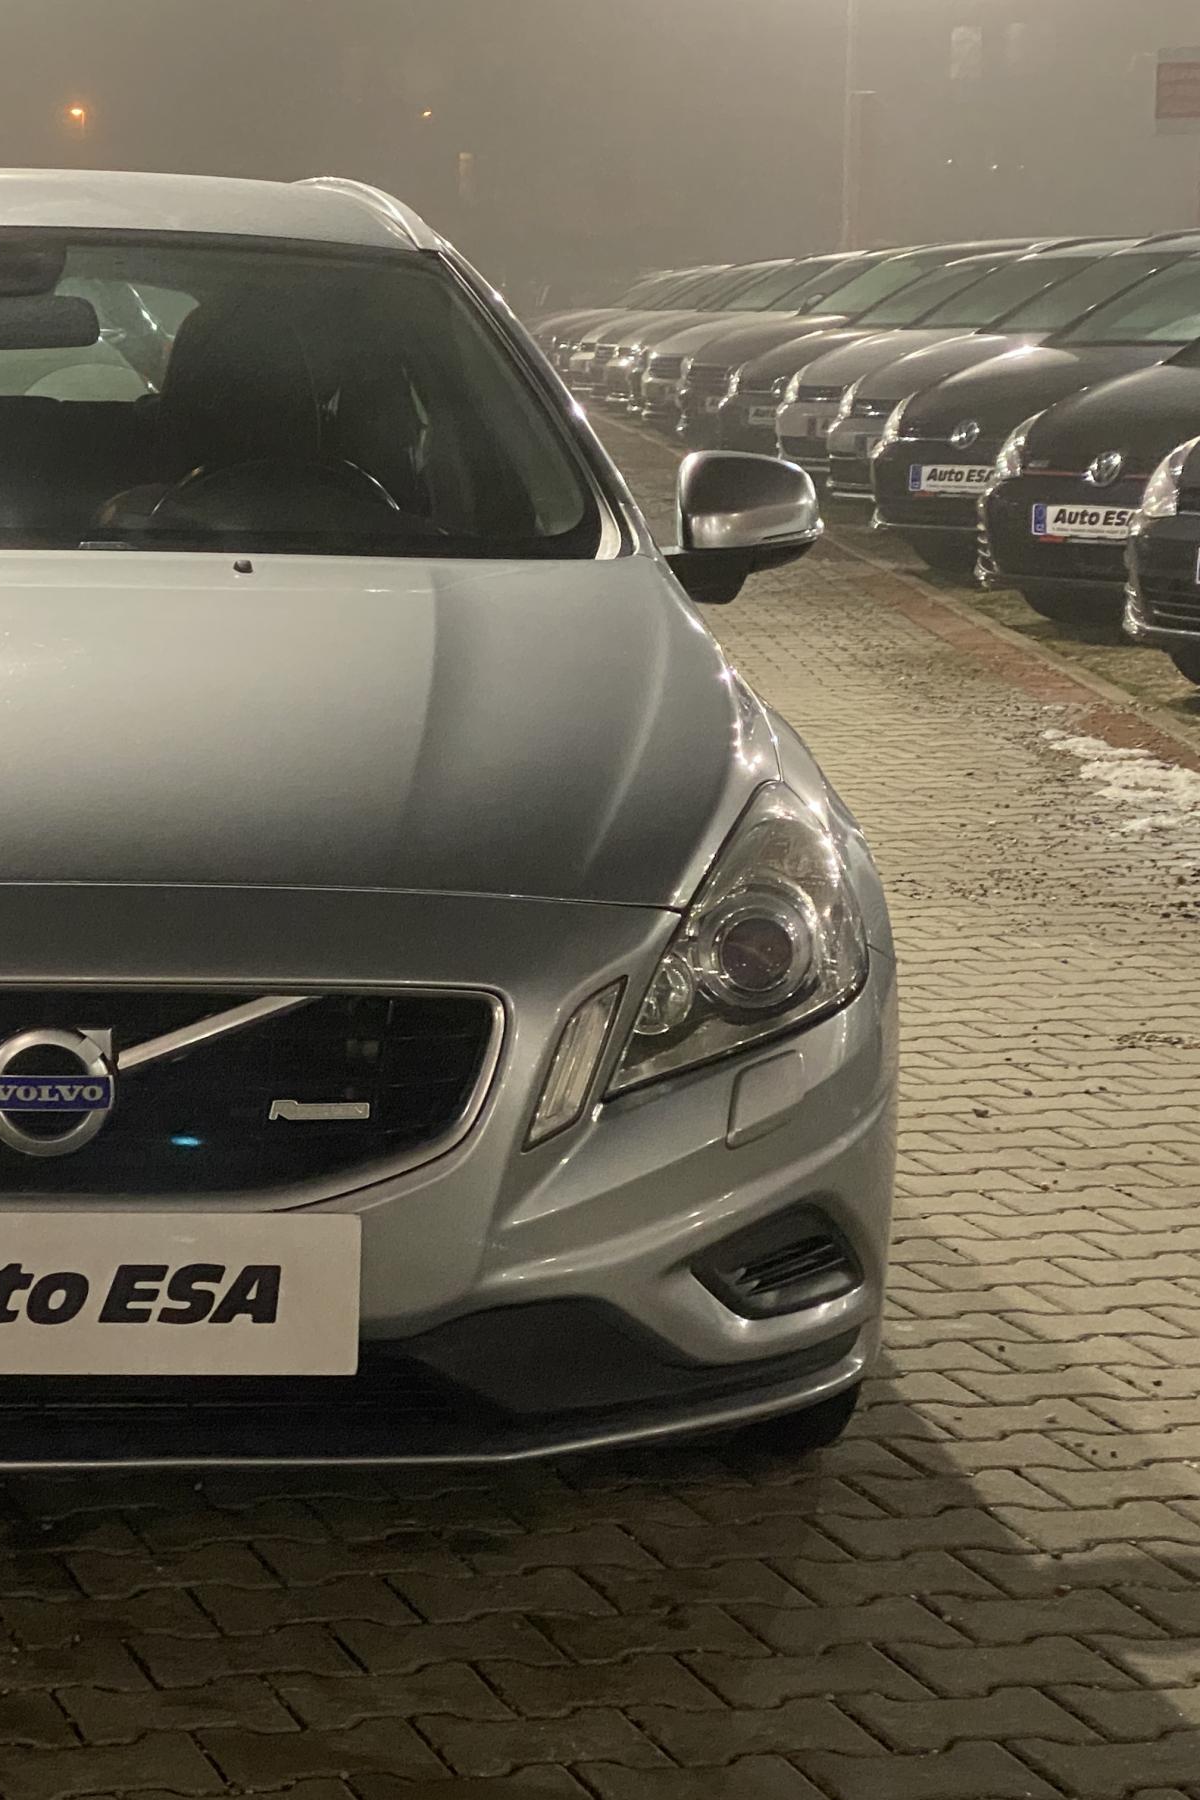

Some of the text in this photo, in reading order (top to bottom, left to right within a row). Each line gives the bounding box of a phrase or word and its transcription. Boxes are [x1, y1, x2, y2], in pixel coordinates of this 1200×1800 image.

[926, 468, 966, 482] Auto
[1053, 508, 1100, 525] Auto
[98, 1263, 282, 1324] ESA
